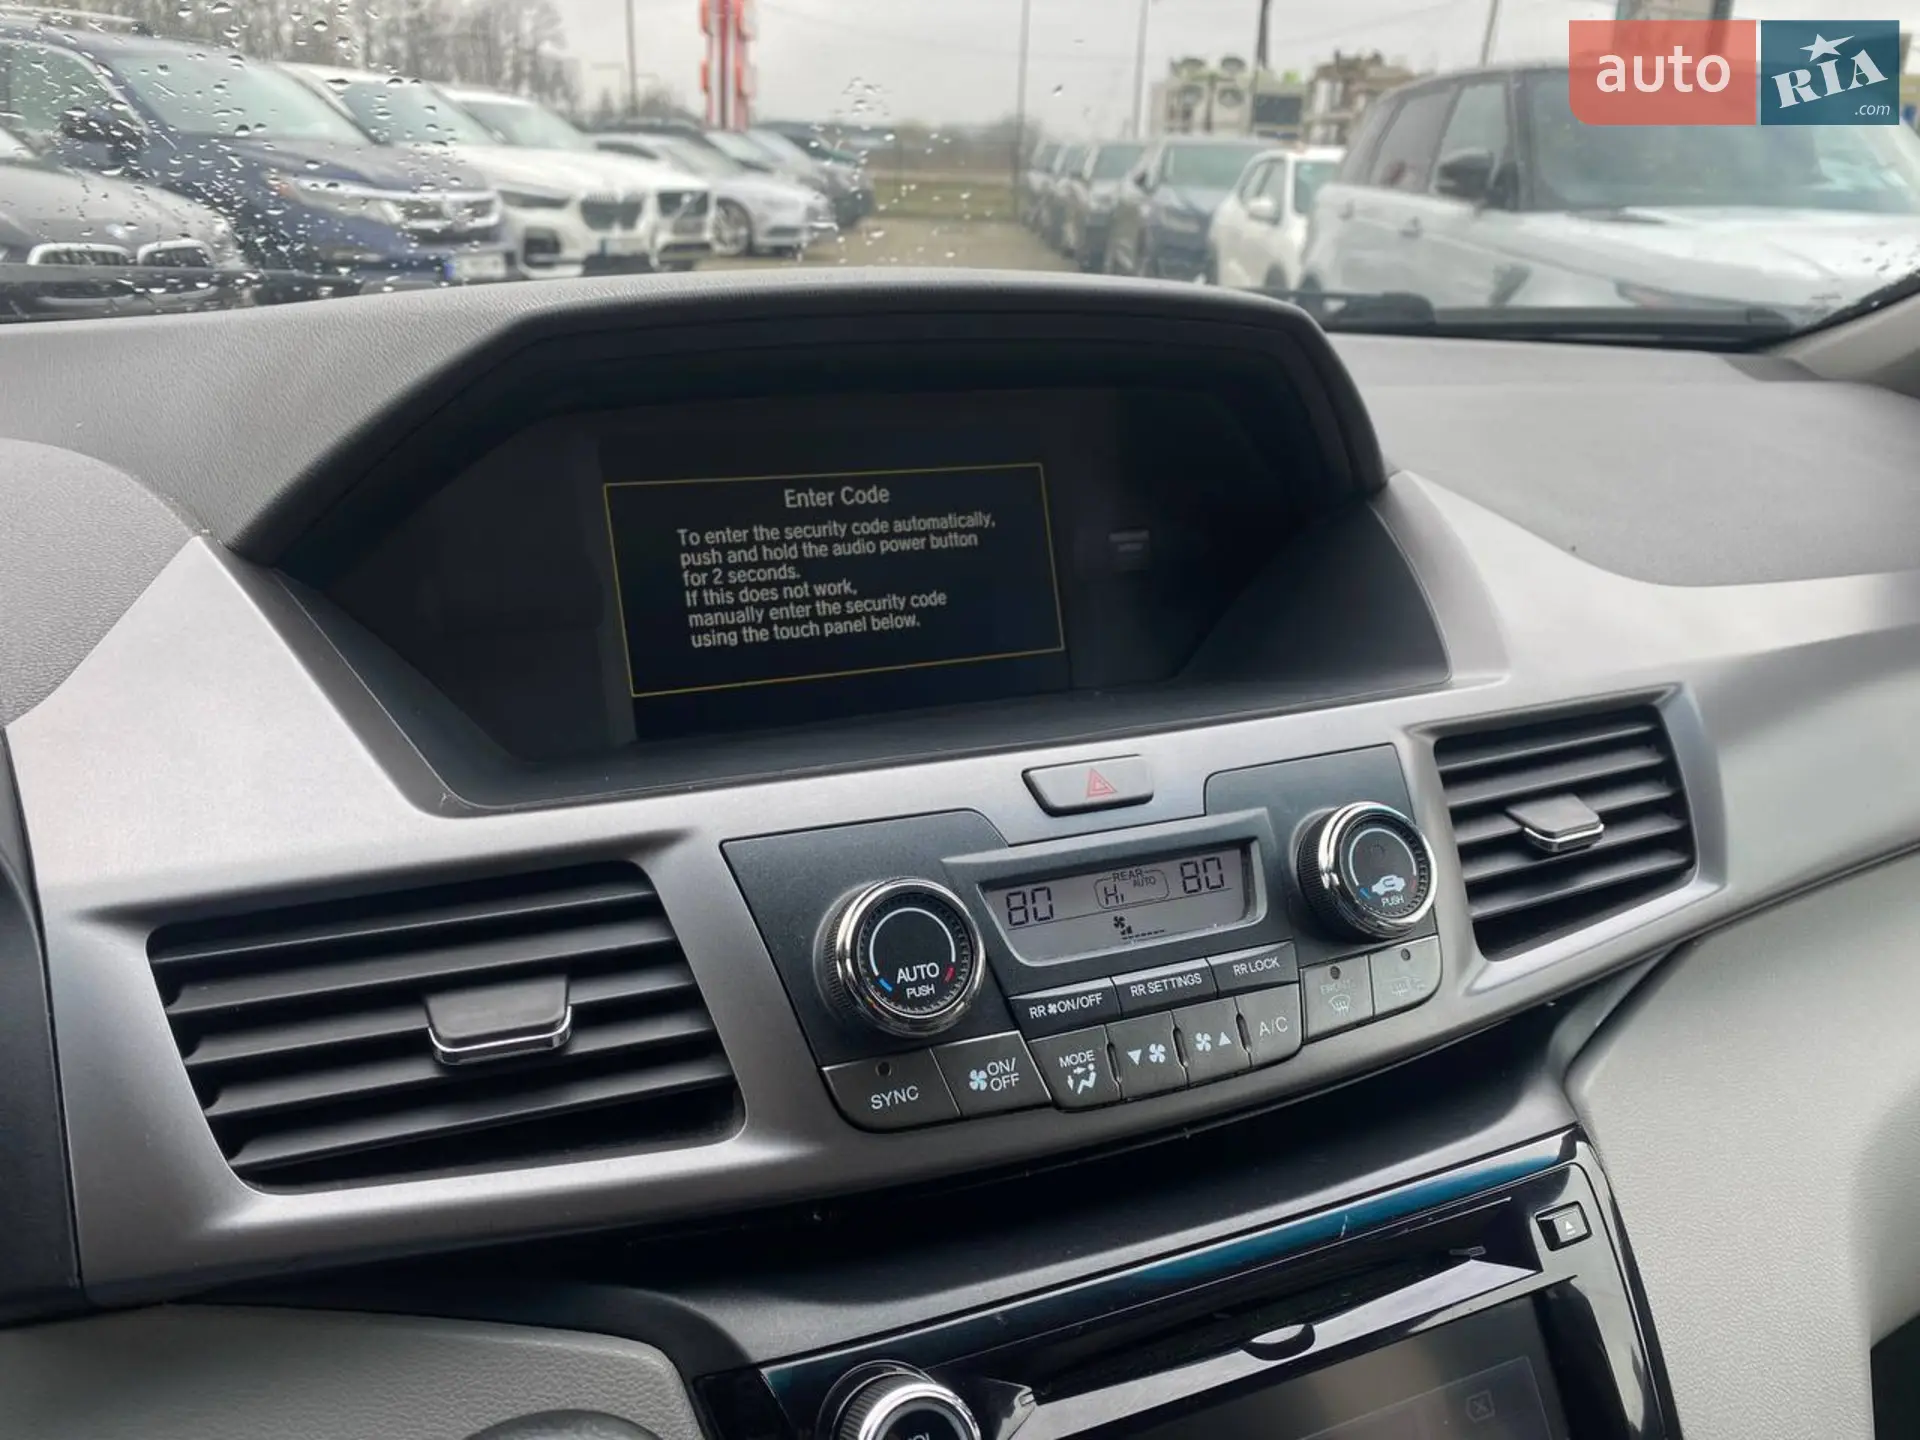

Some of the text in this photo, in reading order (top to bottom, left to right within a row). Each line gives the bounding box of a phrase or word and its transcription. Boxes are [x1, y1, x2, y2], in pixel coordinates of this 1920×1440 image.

[784, 484, 890, 508] Enter Code
[676, 511, 996, 546] To enter the security code automatically,
[680, 532, 978, 569] push and hold the audio power button
[683, 564, 801, 587] for 2 seconds.
[685, 589, 698, 607] If
[703, 587, 735, 606] this
[739, 586, 779, 603] does
[783, 581, 810, 599] not
[688, 590, 947, 628] manually enter the security code
[691, 613, 921, 648] using the touch panel below.
[1112, 868, 1144, 882] REAR
[1133, 875, 1157, 889] AUTO
[1180, 856, 1225, 895] 80
[1006, 885, 1054, 926] 80
[1381, 895, 1404, 907] PUSH
[896, 962, 940, 985] AUTO
[1232, 956, 1281, 976] RR LOCK
[906, 984, 936, 999] PUSH
[1130, 973, 1203, 997] RR SETTINGS
[1029, 992, 1104, 1020] RR ON/OFF
[1258, 1016, 1289, 1037] A/C
[987, 1057, 1017, 1077] ON/
[1059, 1050, 1095, 1068] MODE
[990, 1073, 1020, 1092] OFF
[870, 1085, 919, 1110] SYNC
